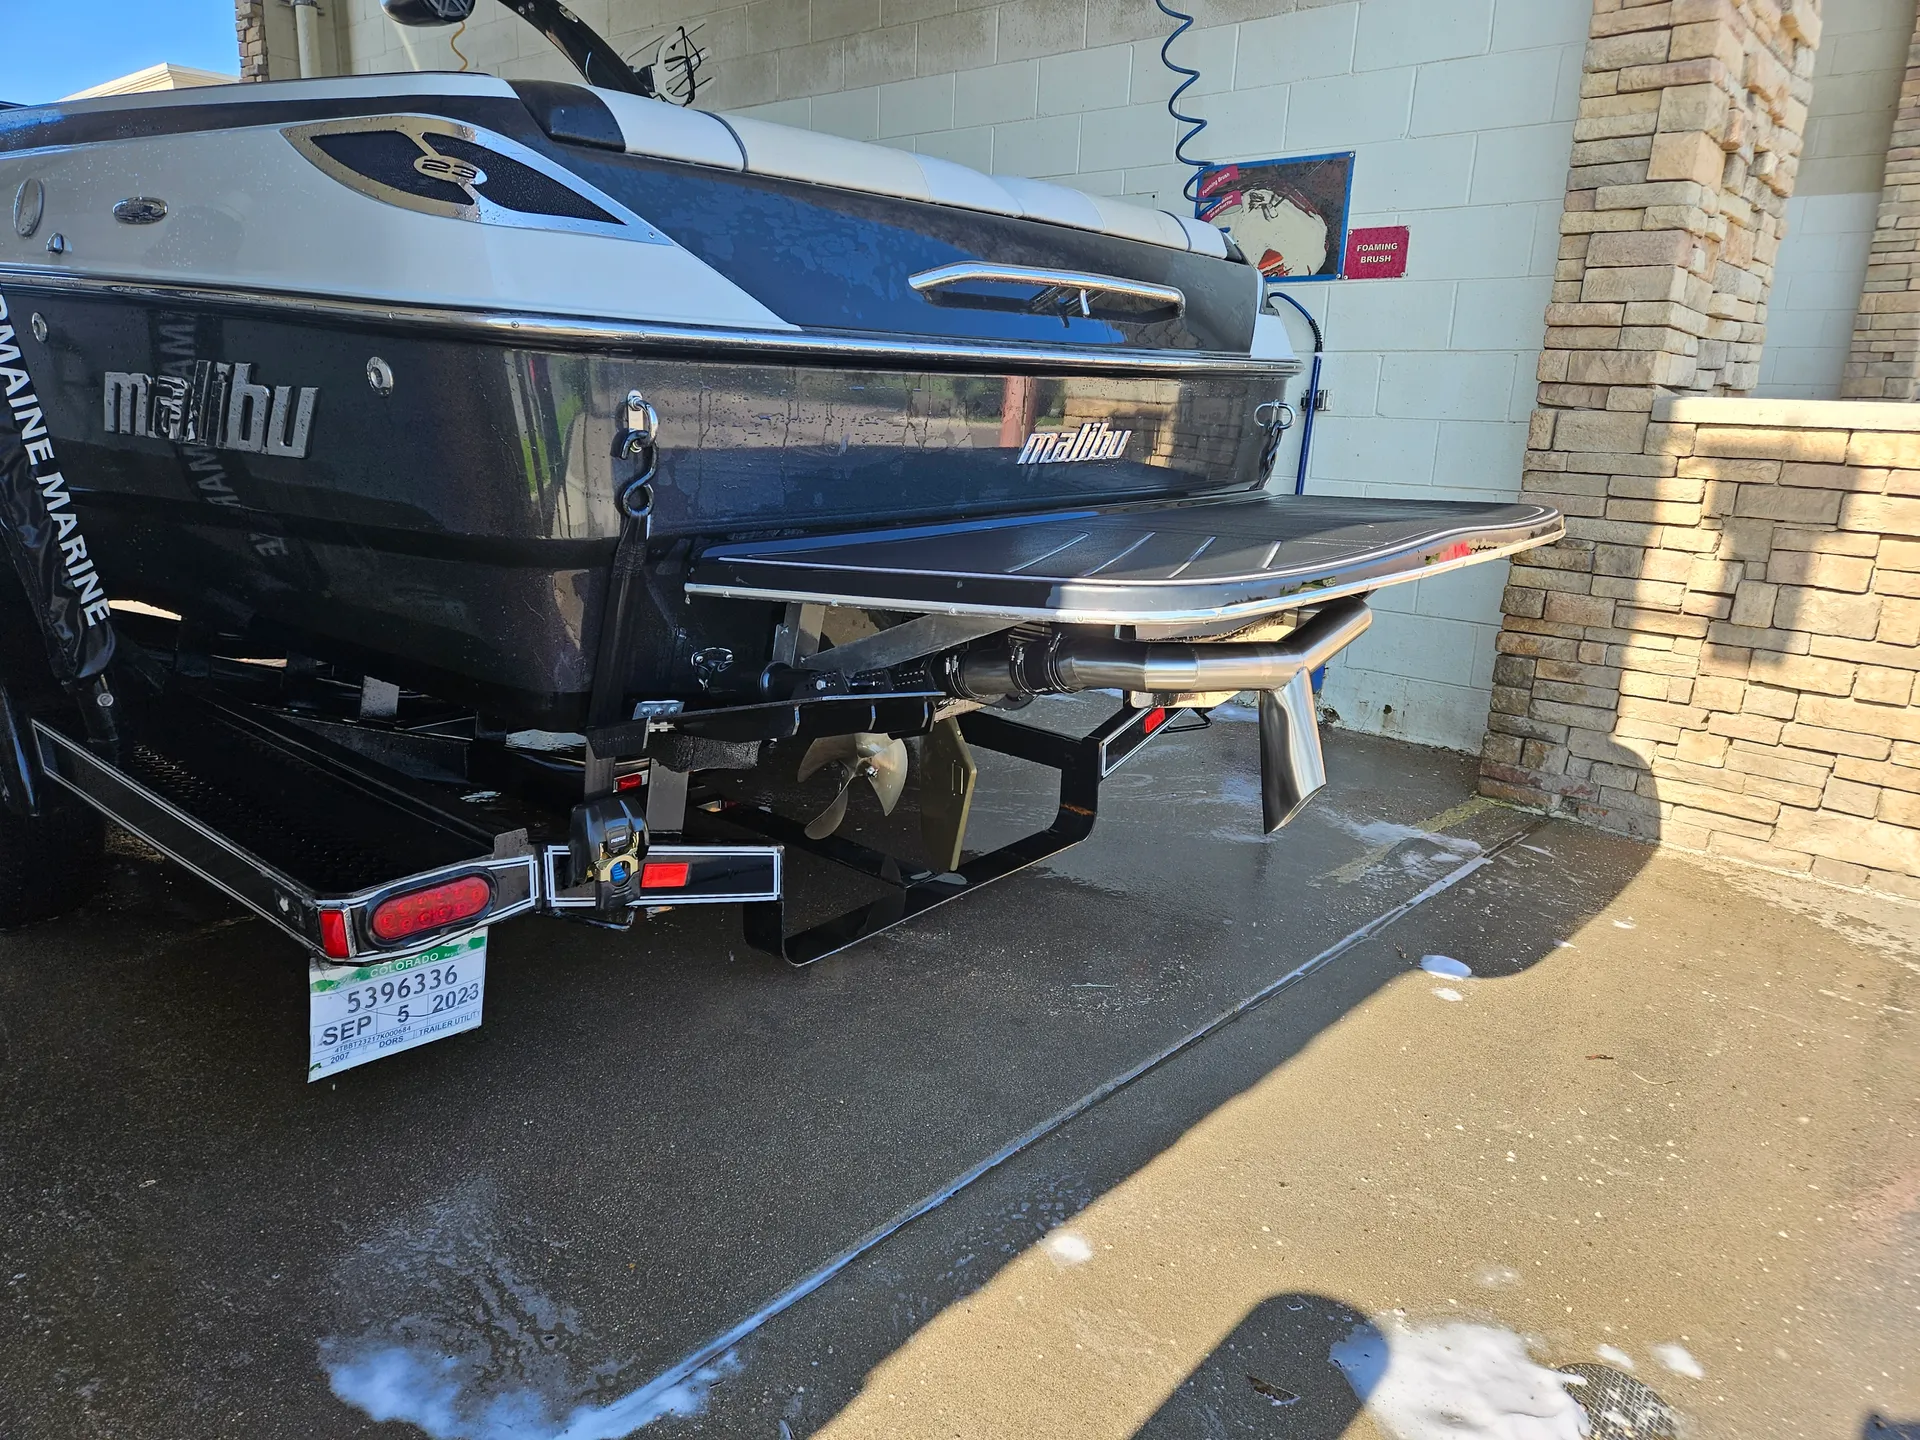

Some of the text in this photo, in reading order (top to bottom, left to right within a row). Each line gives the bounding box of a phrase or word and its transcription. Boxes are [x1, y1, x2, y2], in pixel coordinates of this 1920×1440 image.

[1202, 172, 1230, 196] Foaming Brush
[1356, 242, 1398, 252] FOAMING
[1360, 255, 1392, 264] BRUSH
[104, 360, 319, 459] malibu
[1017, 422, 1132, 465] malibu
[36, 471, 111, 627] MARINE
[370, 952, 439, 978] COLORADO
[347, 964, 458, 1014] 5396336
[322, 982, 479, 1047] SEP 5 2023
[330, 1010, 480, 1064] 2007 DORS TRAILER UTILITY
